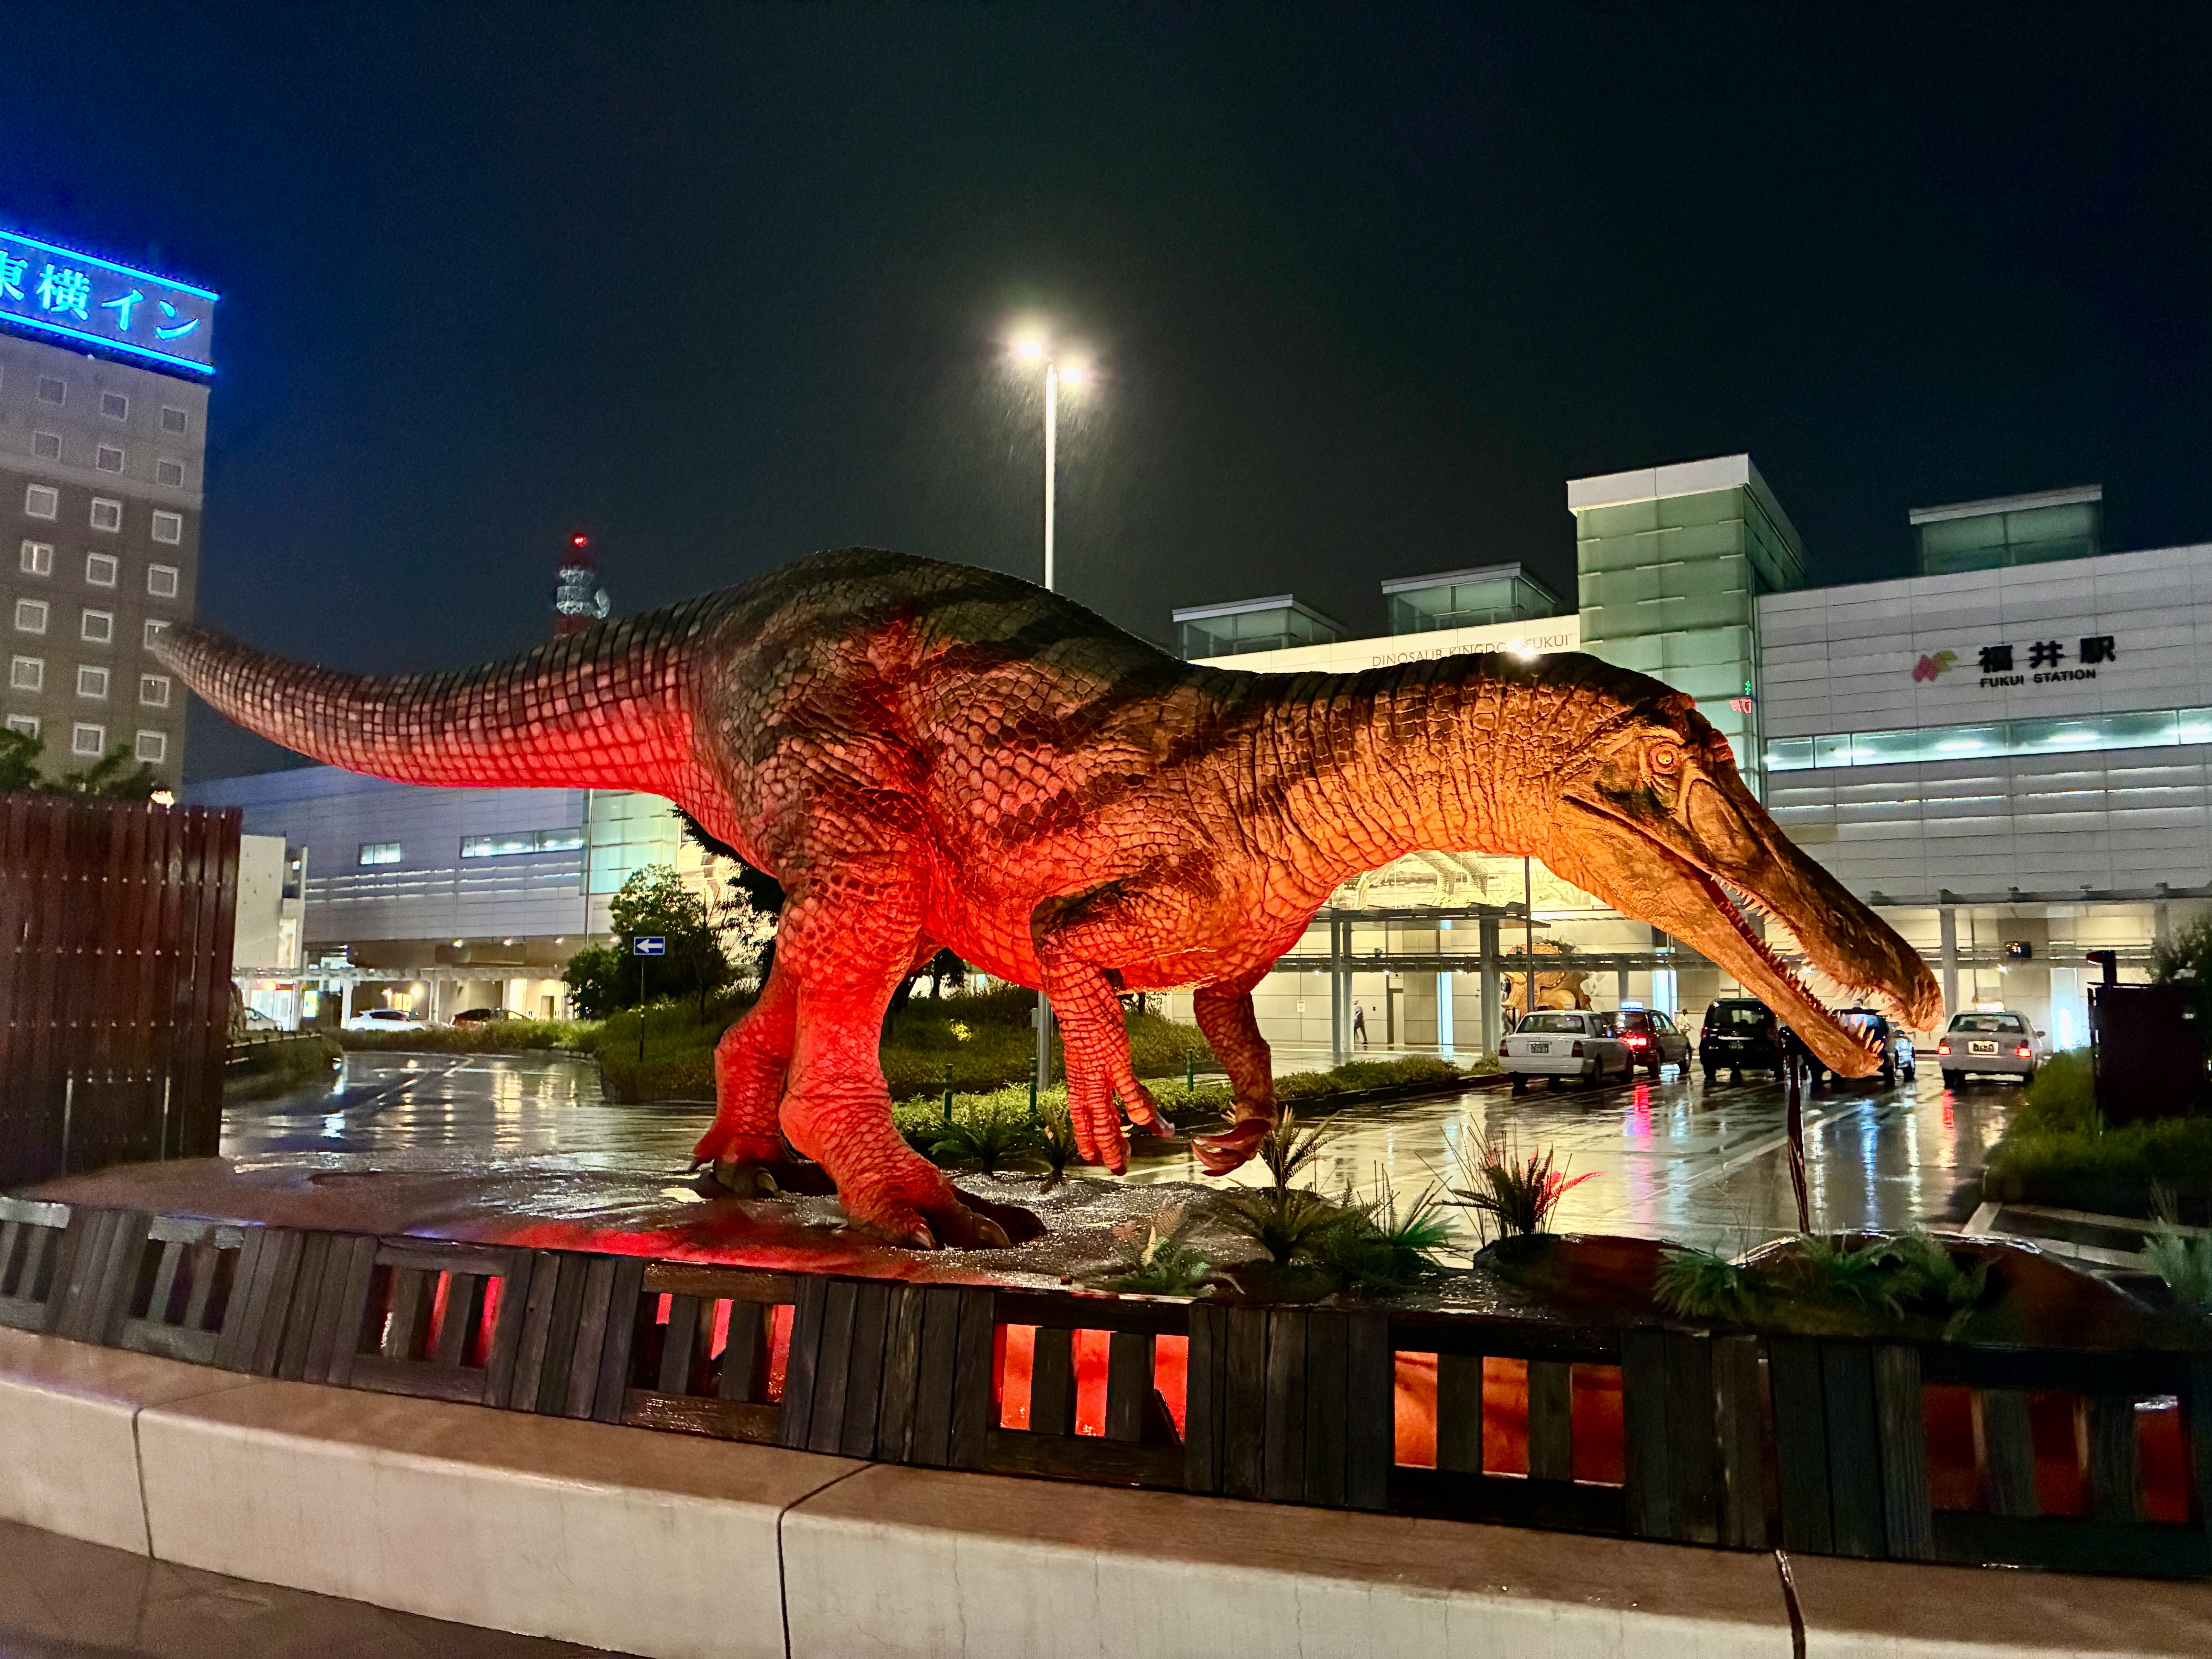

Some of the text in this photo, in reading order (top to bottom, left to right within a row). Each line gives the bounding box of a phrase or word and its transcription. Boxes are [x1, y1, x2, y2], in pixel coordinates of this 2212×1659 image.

[1372, 649, 1442, 666] DINOSAUR
[1449, 642, 1508, 655] KINGDO
[1978, 635, 2116, 673] 福井駅
[1980, 669, 2096, 688] FUKUI STATION
